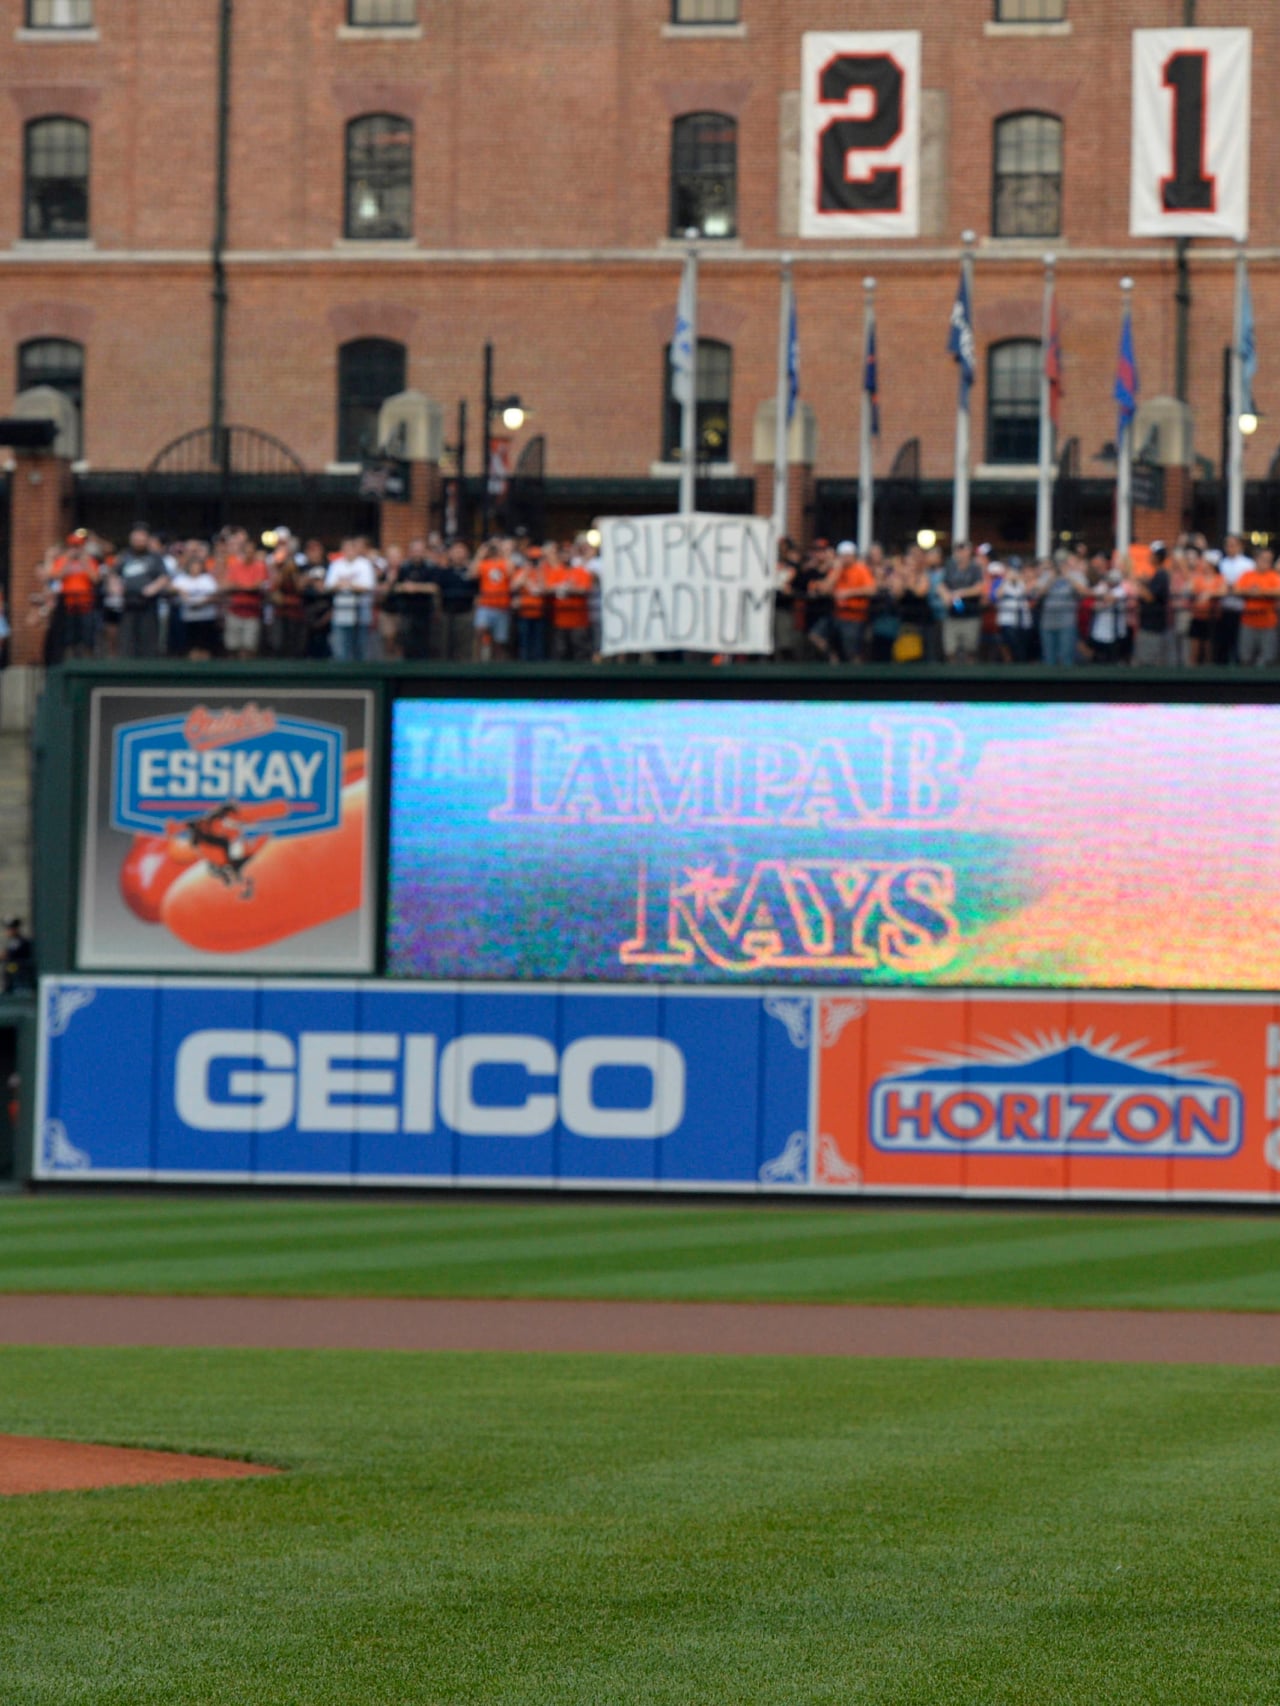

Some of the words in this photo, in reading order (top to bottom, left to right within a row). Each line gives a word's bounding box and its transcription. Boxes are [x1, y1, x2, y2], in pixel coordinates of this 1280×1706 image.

[815, 51, 906, 215] 2
[1158, 48, 1218, 215] 1
[610, 518, 773, 582] RIPKEN
[603, 581, 771, 647] STADIUM
[137, 749, 324, 799] ESSKAY
[620, 850, 962, 973] RAYS
[174, 1028, 686, 1140] GEICO
[883, 1089, 1232, 1146] HORIZON
